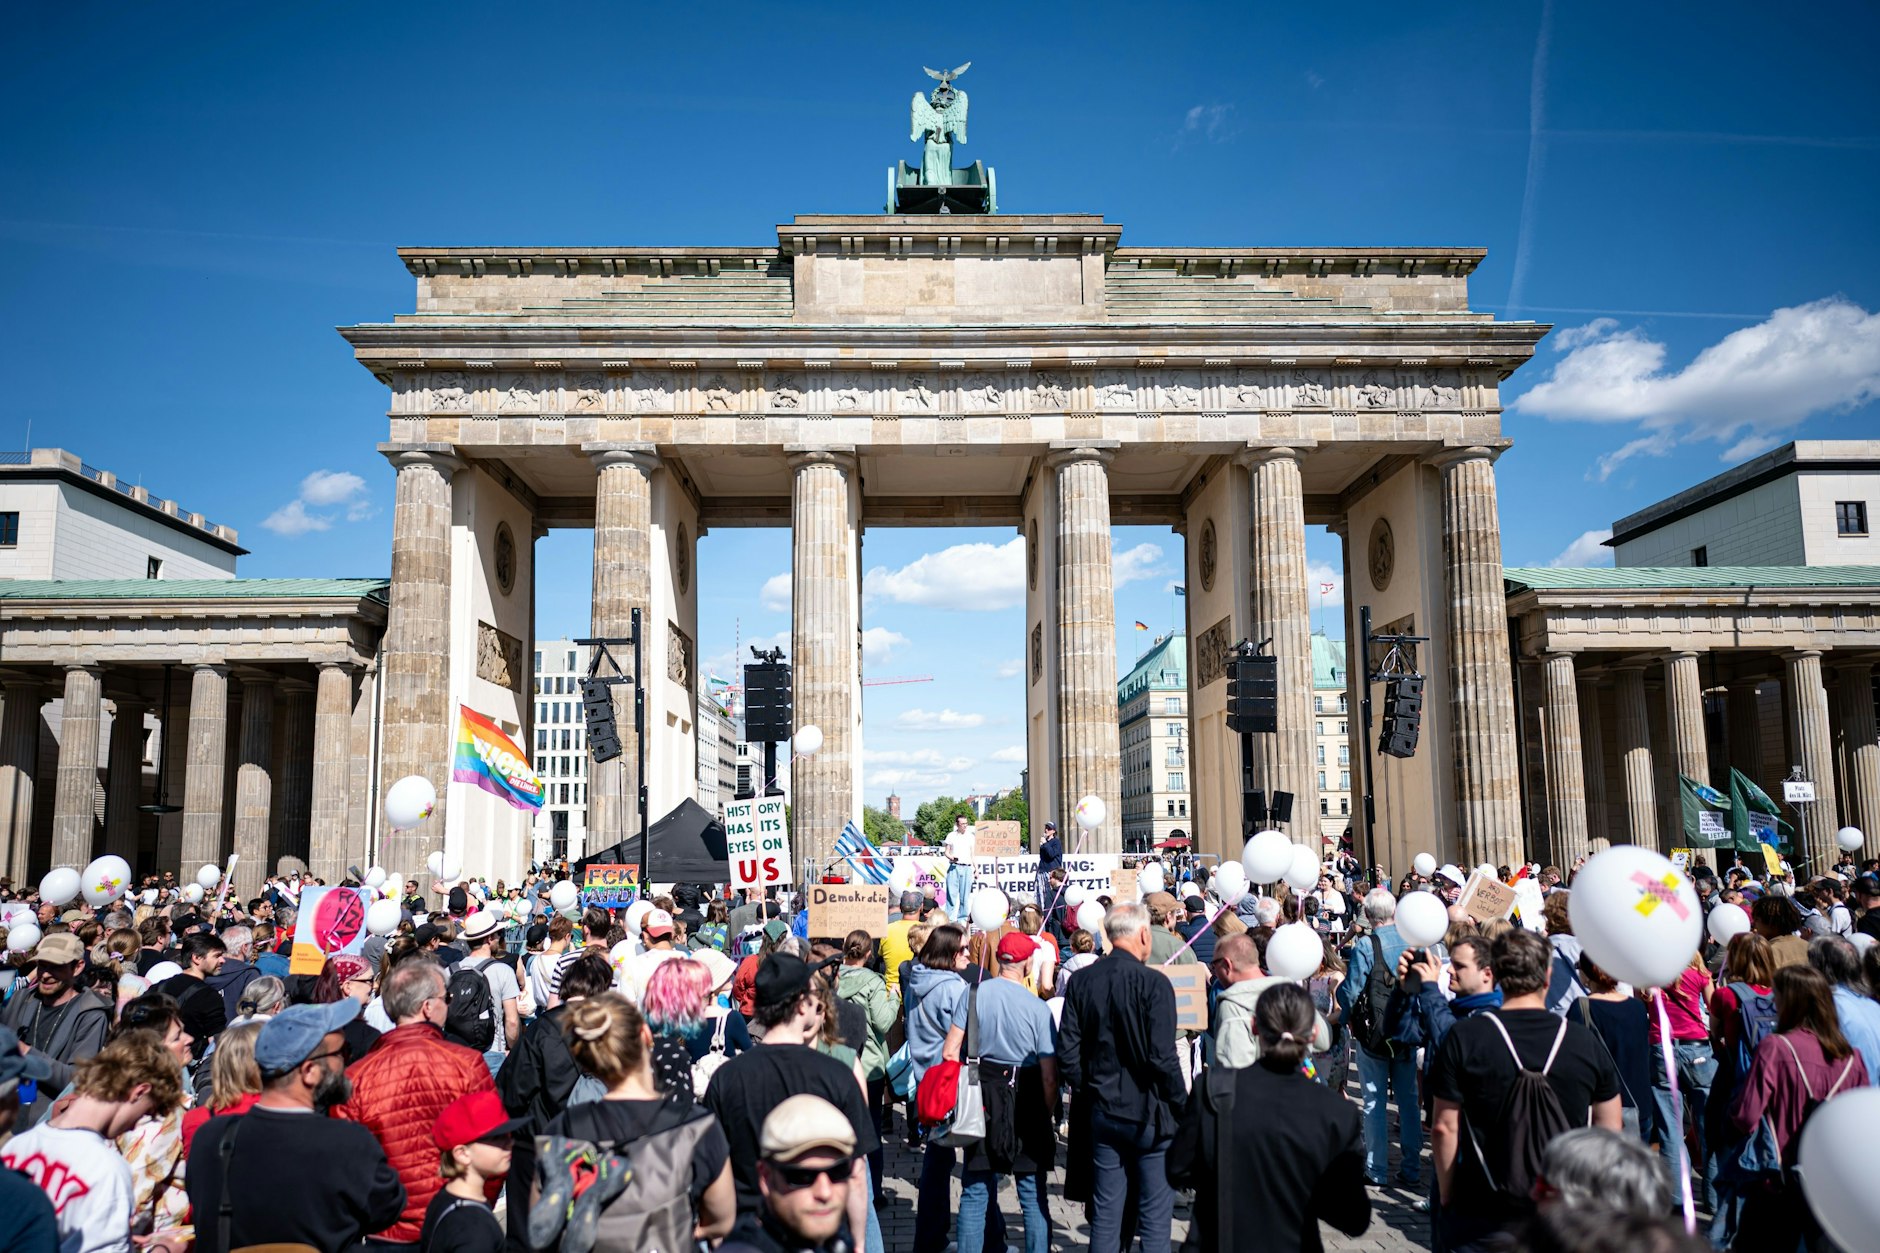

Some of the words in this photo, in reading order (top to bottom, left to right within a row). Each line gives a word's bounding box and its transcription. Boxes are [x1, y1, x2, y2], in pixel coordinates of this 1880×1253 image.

[727, 822, 753, 835] HAS
[760, 819, 781, 832] ITS
[728, 840, 756, 854] EYES
[762, 837, 783, 851] ON
[738, 857, 780, 883] US
[1018, 860, 1095, 875] HANG:
[588, 869, 635, 885] FCK
[1068, 877, 1110, 890] ETZT!
[339, 890, 363, 909] FC
[813, 888, 887, 905] Demokratie
[1477, 887, 1505, 906] VERBOT
